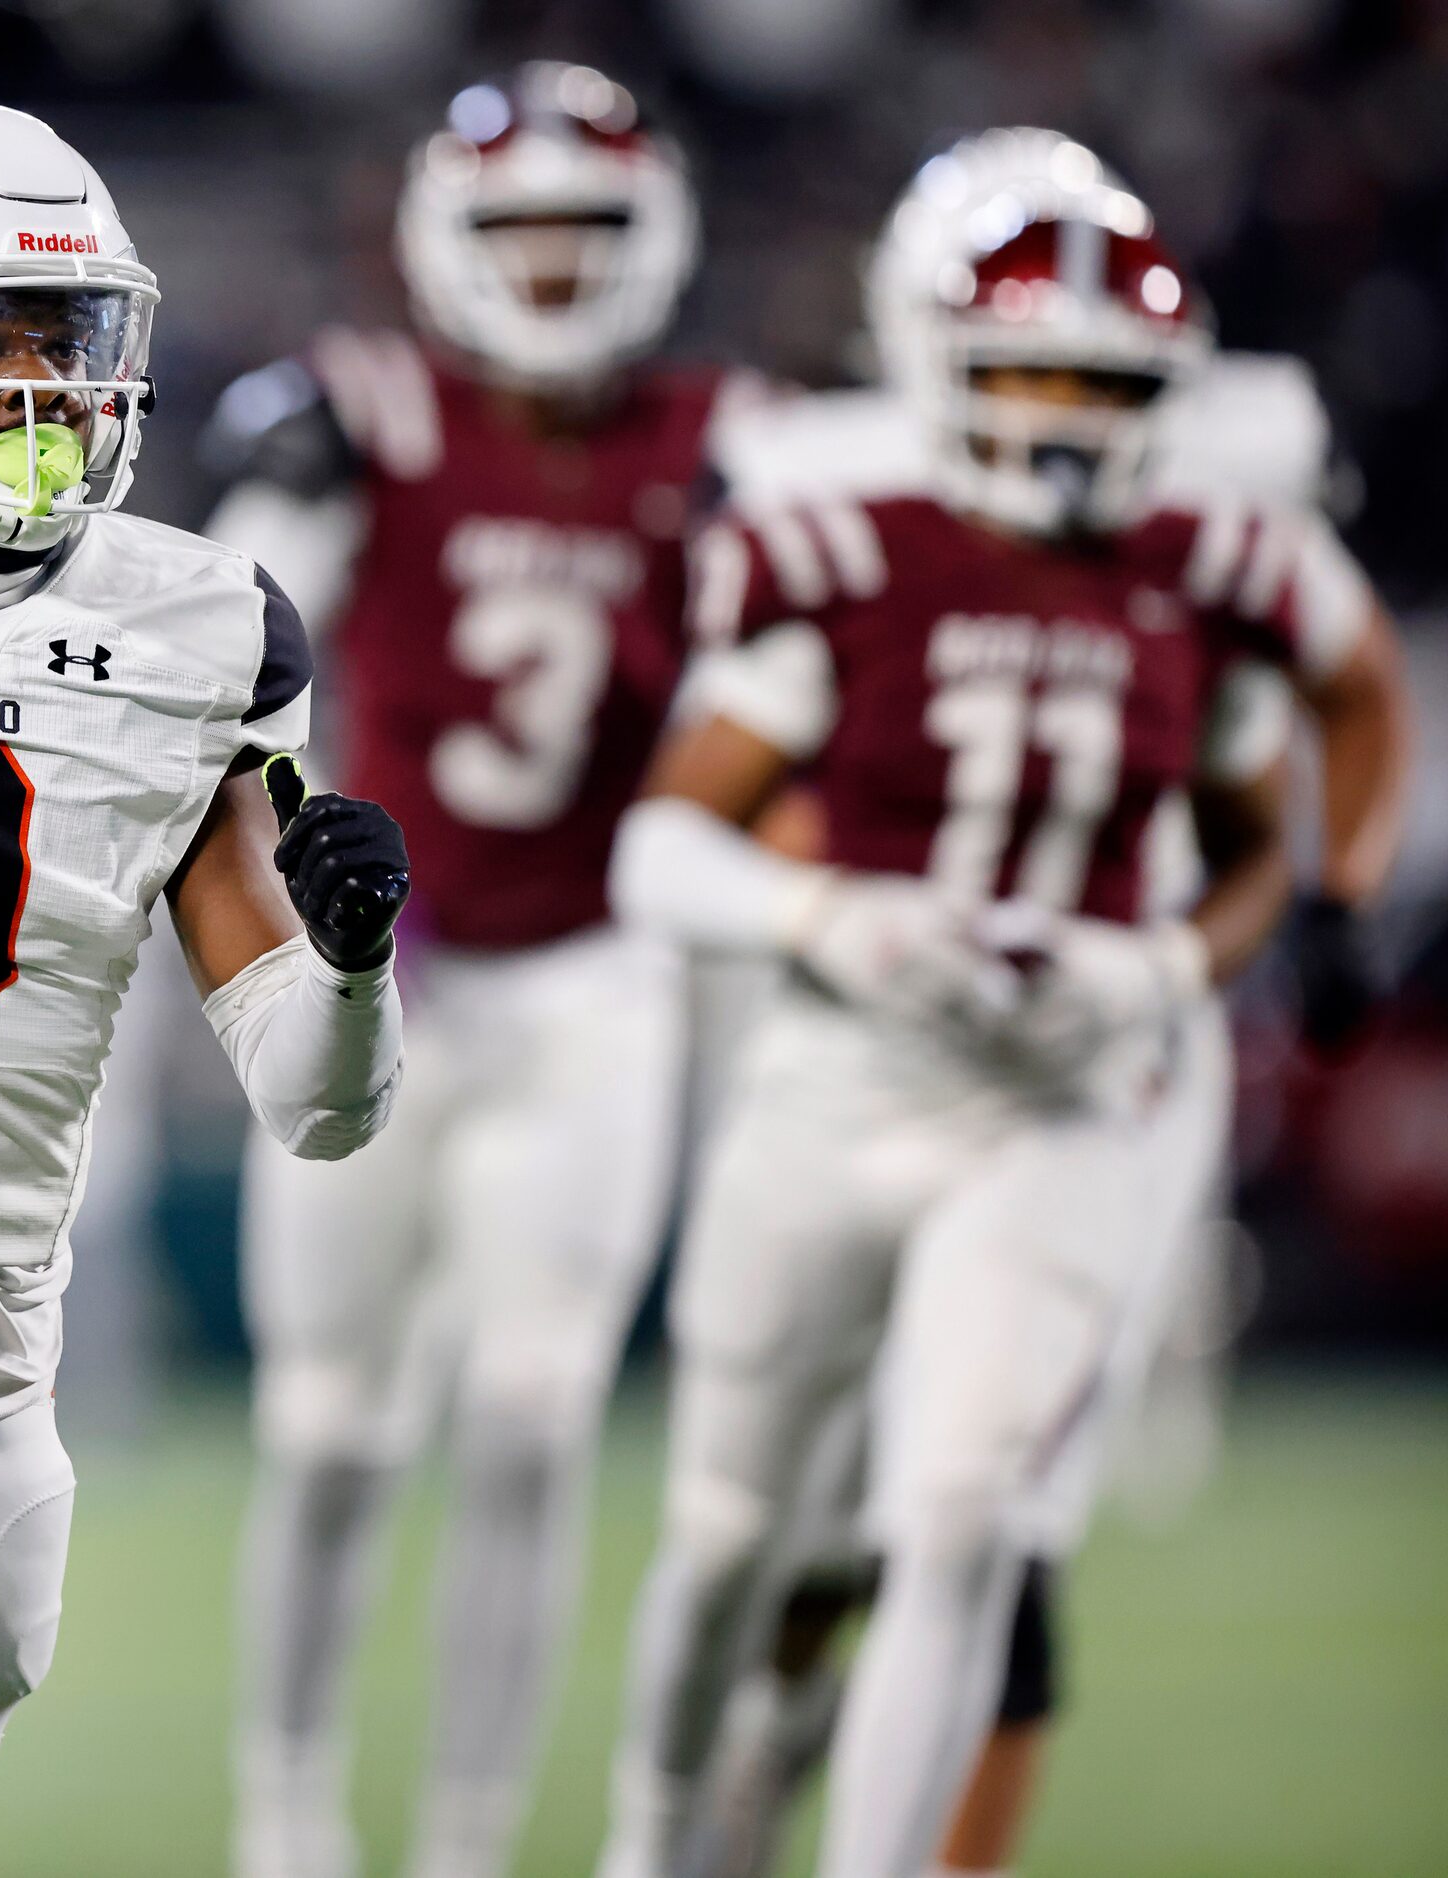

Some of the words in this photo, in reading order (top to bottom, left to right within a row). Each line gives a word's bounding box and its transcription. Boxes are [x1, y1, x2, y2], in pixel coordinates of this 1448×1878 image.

[17, 232, 98, 254] Riddell
[431, 590, 614, 832] 3
[924, 692, 1121, 912] 11
